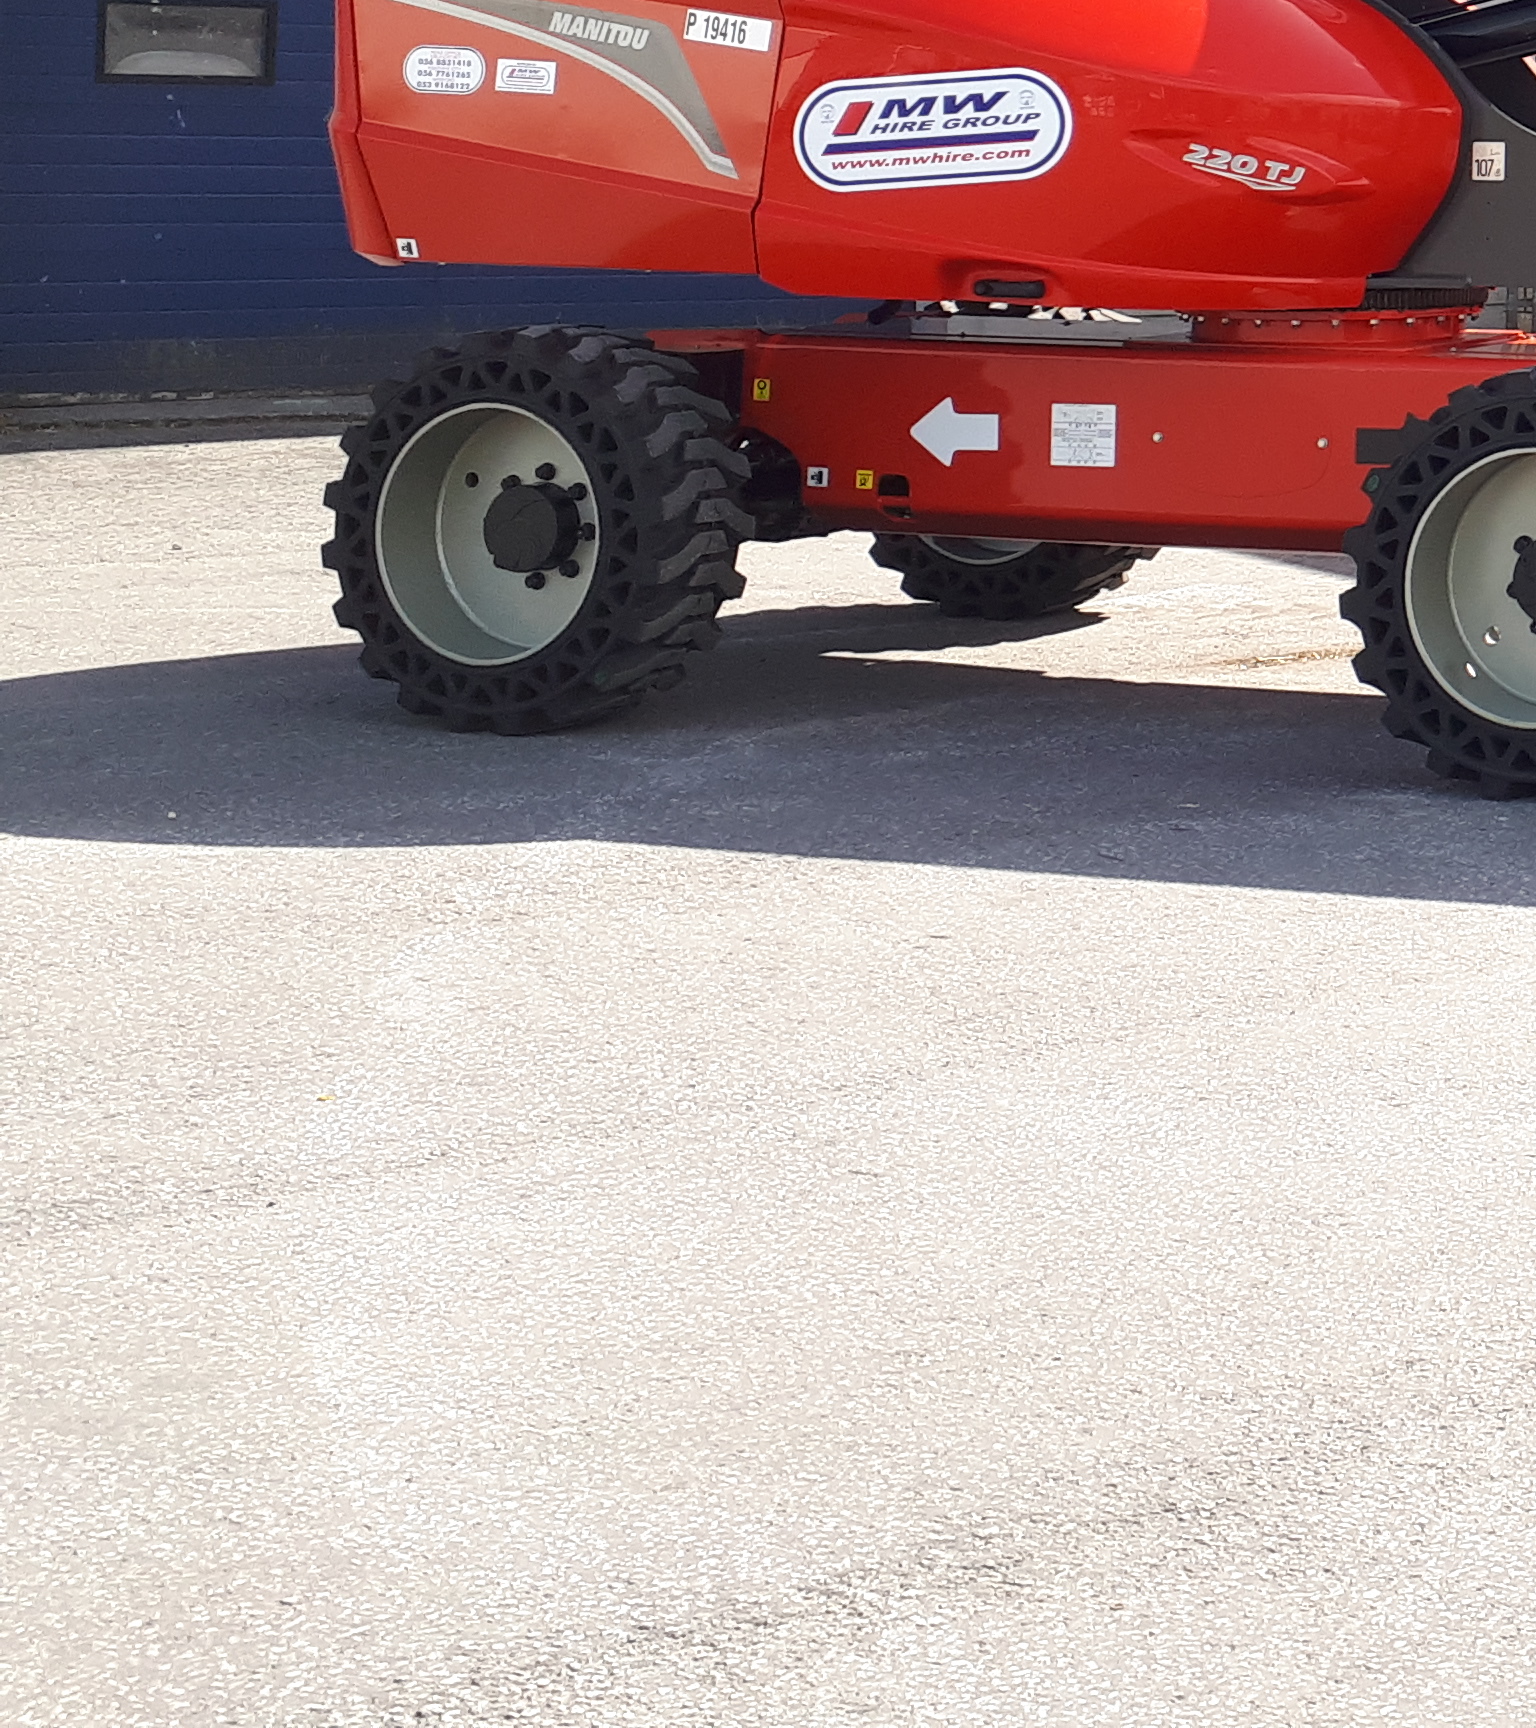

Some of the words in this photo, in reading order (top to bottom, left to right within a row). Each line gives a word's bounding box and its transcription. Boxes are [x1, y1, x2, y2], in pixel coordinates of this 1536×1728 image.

[548, 10, 651, 52] MANITOU
[685, 12, 698, 37] P
[703, 15, 748, 45] 19416
[877, 91, 1011, 120] MW
[869, 119, 936, 135] HIRE
[942, 112, 1042, 130] GROUP
[830, 148, 1032, 171] www.mwhire.com
[1182, 142, 1259, 175] 220
[1264, 159, 1306, 184] TJ
[1474, 158, 1495, 178] 107
